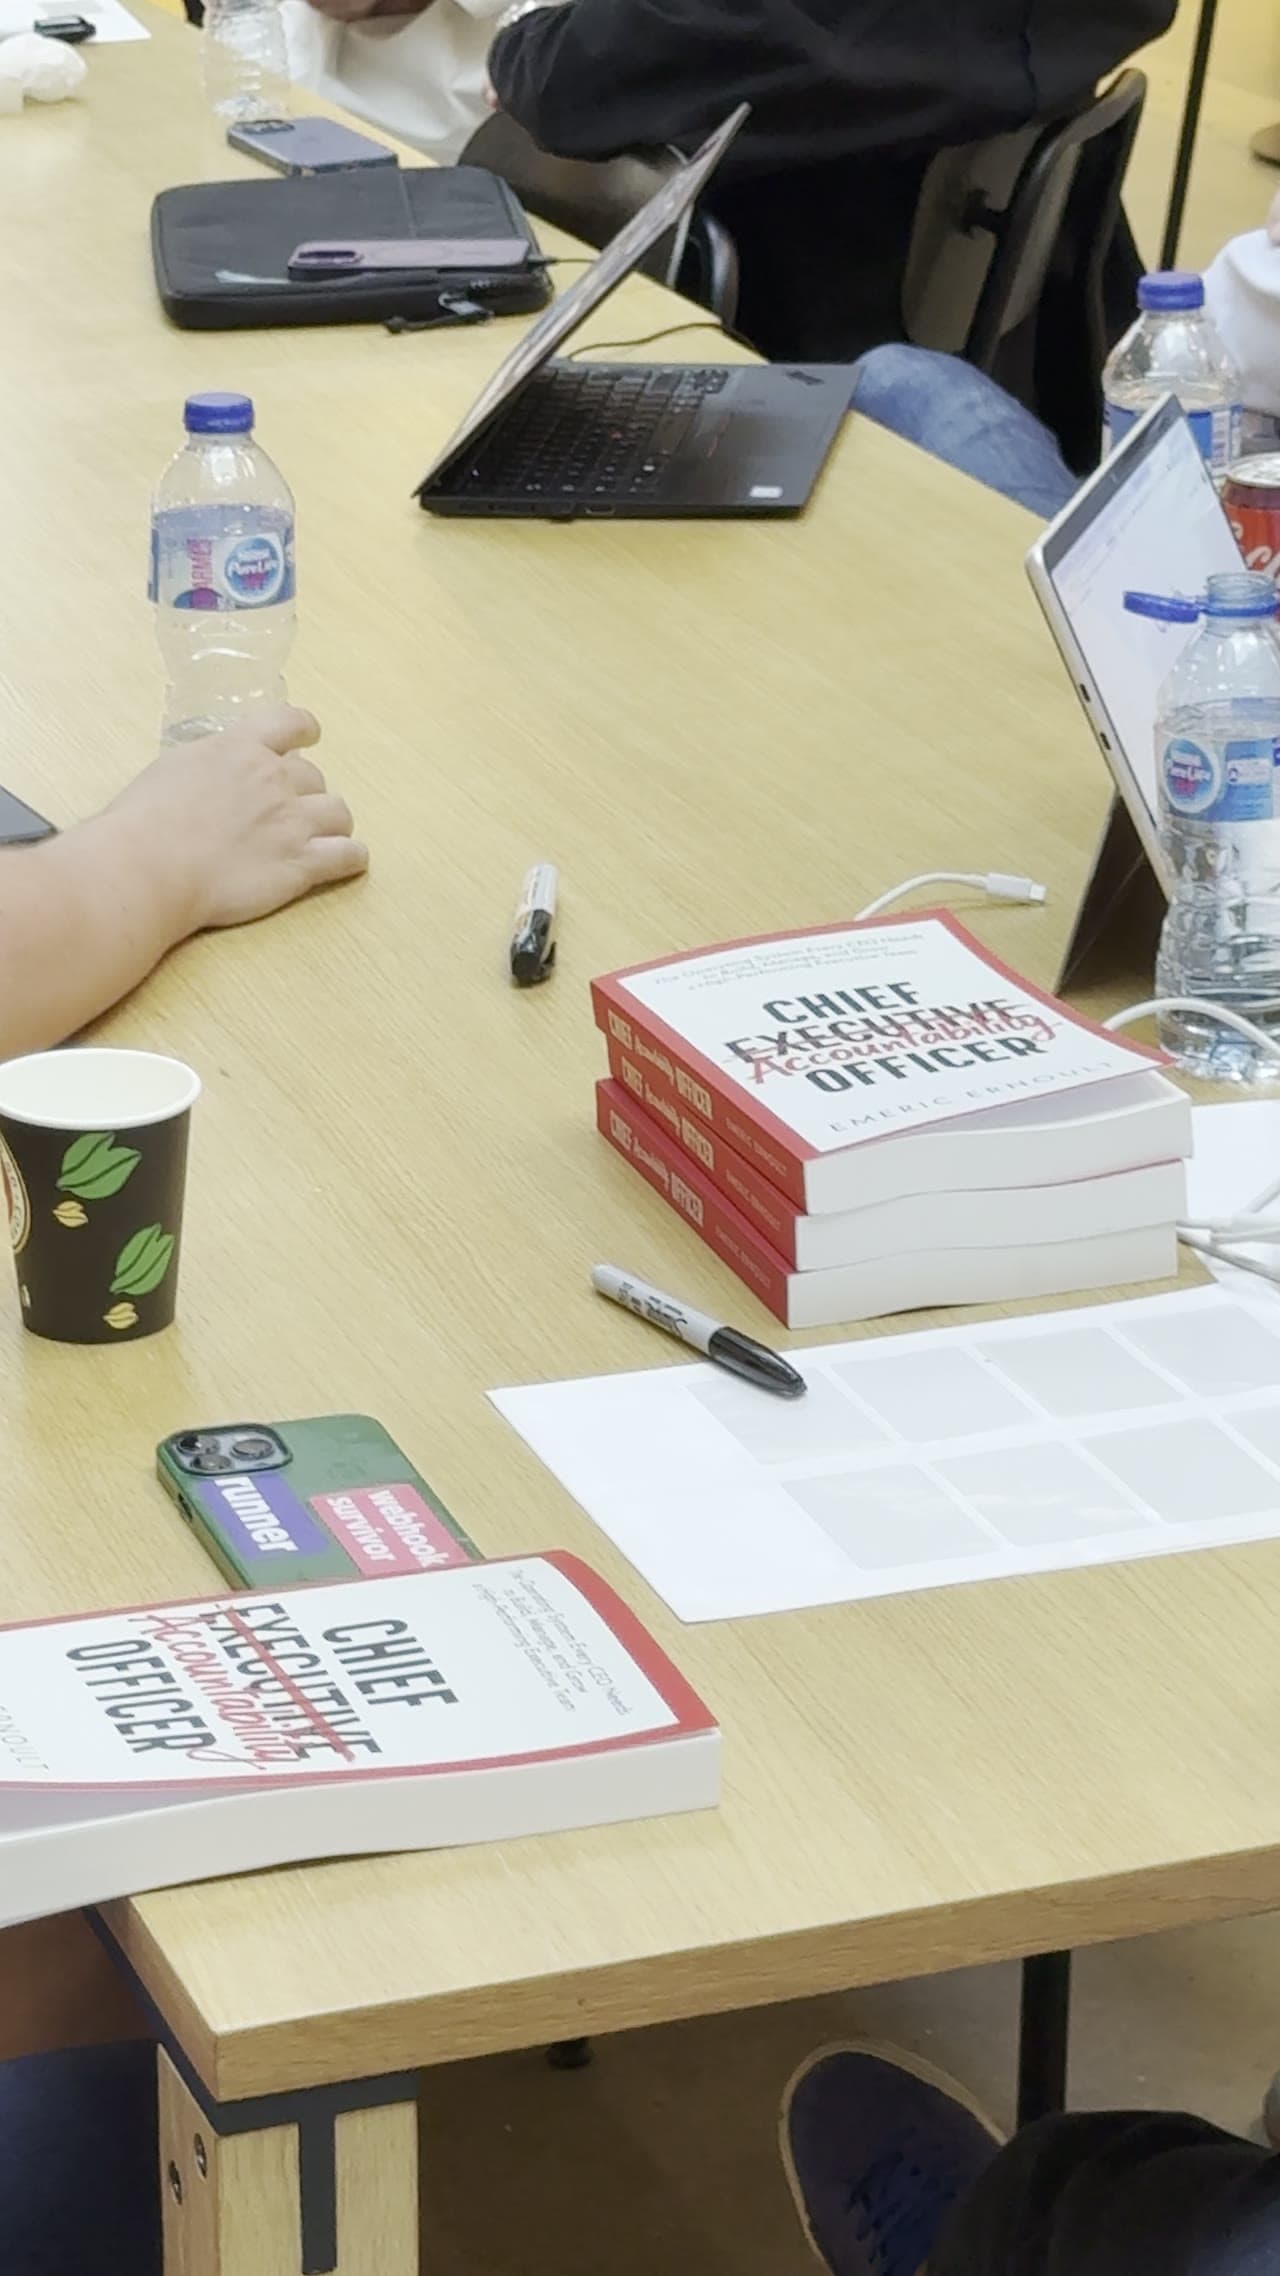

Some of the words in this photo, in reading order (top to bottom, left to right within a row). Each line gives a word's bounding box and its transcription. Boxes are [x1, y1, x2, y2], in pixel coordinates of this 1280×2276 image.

[725, 998, 1021, 1063] EXECUTIVE
[762, 981, 921, 1024] CHIEF
[747, 1012, 1056, 1085] Accountability
[804, 1036, 1048, 1093] OFFICER
[830, 1094, 954, 1133] EMERIC
[966, 1062, 1113, 1099] ERNOULT
[214, 1477, 299, 1552] runner
[326, 1496, 397, 1562] survivor
[368, 1489, 449, 1568] webhook
[66, 1639, 217, 1754] OFFICER
[128, 1614, 301, 1770] Accountability
[200, 1602, 383, 1760] EXECUTIVE
[322, 1618, 459, 1706] CHIEF
[569, 1641, 593, 1665] Every
[588, 1666, 613, 1687] CEO
[606, 1686, 634, 1716] Needs
